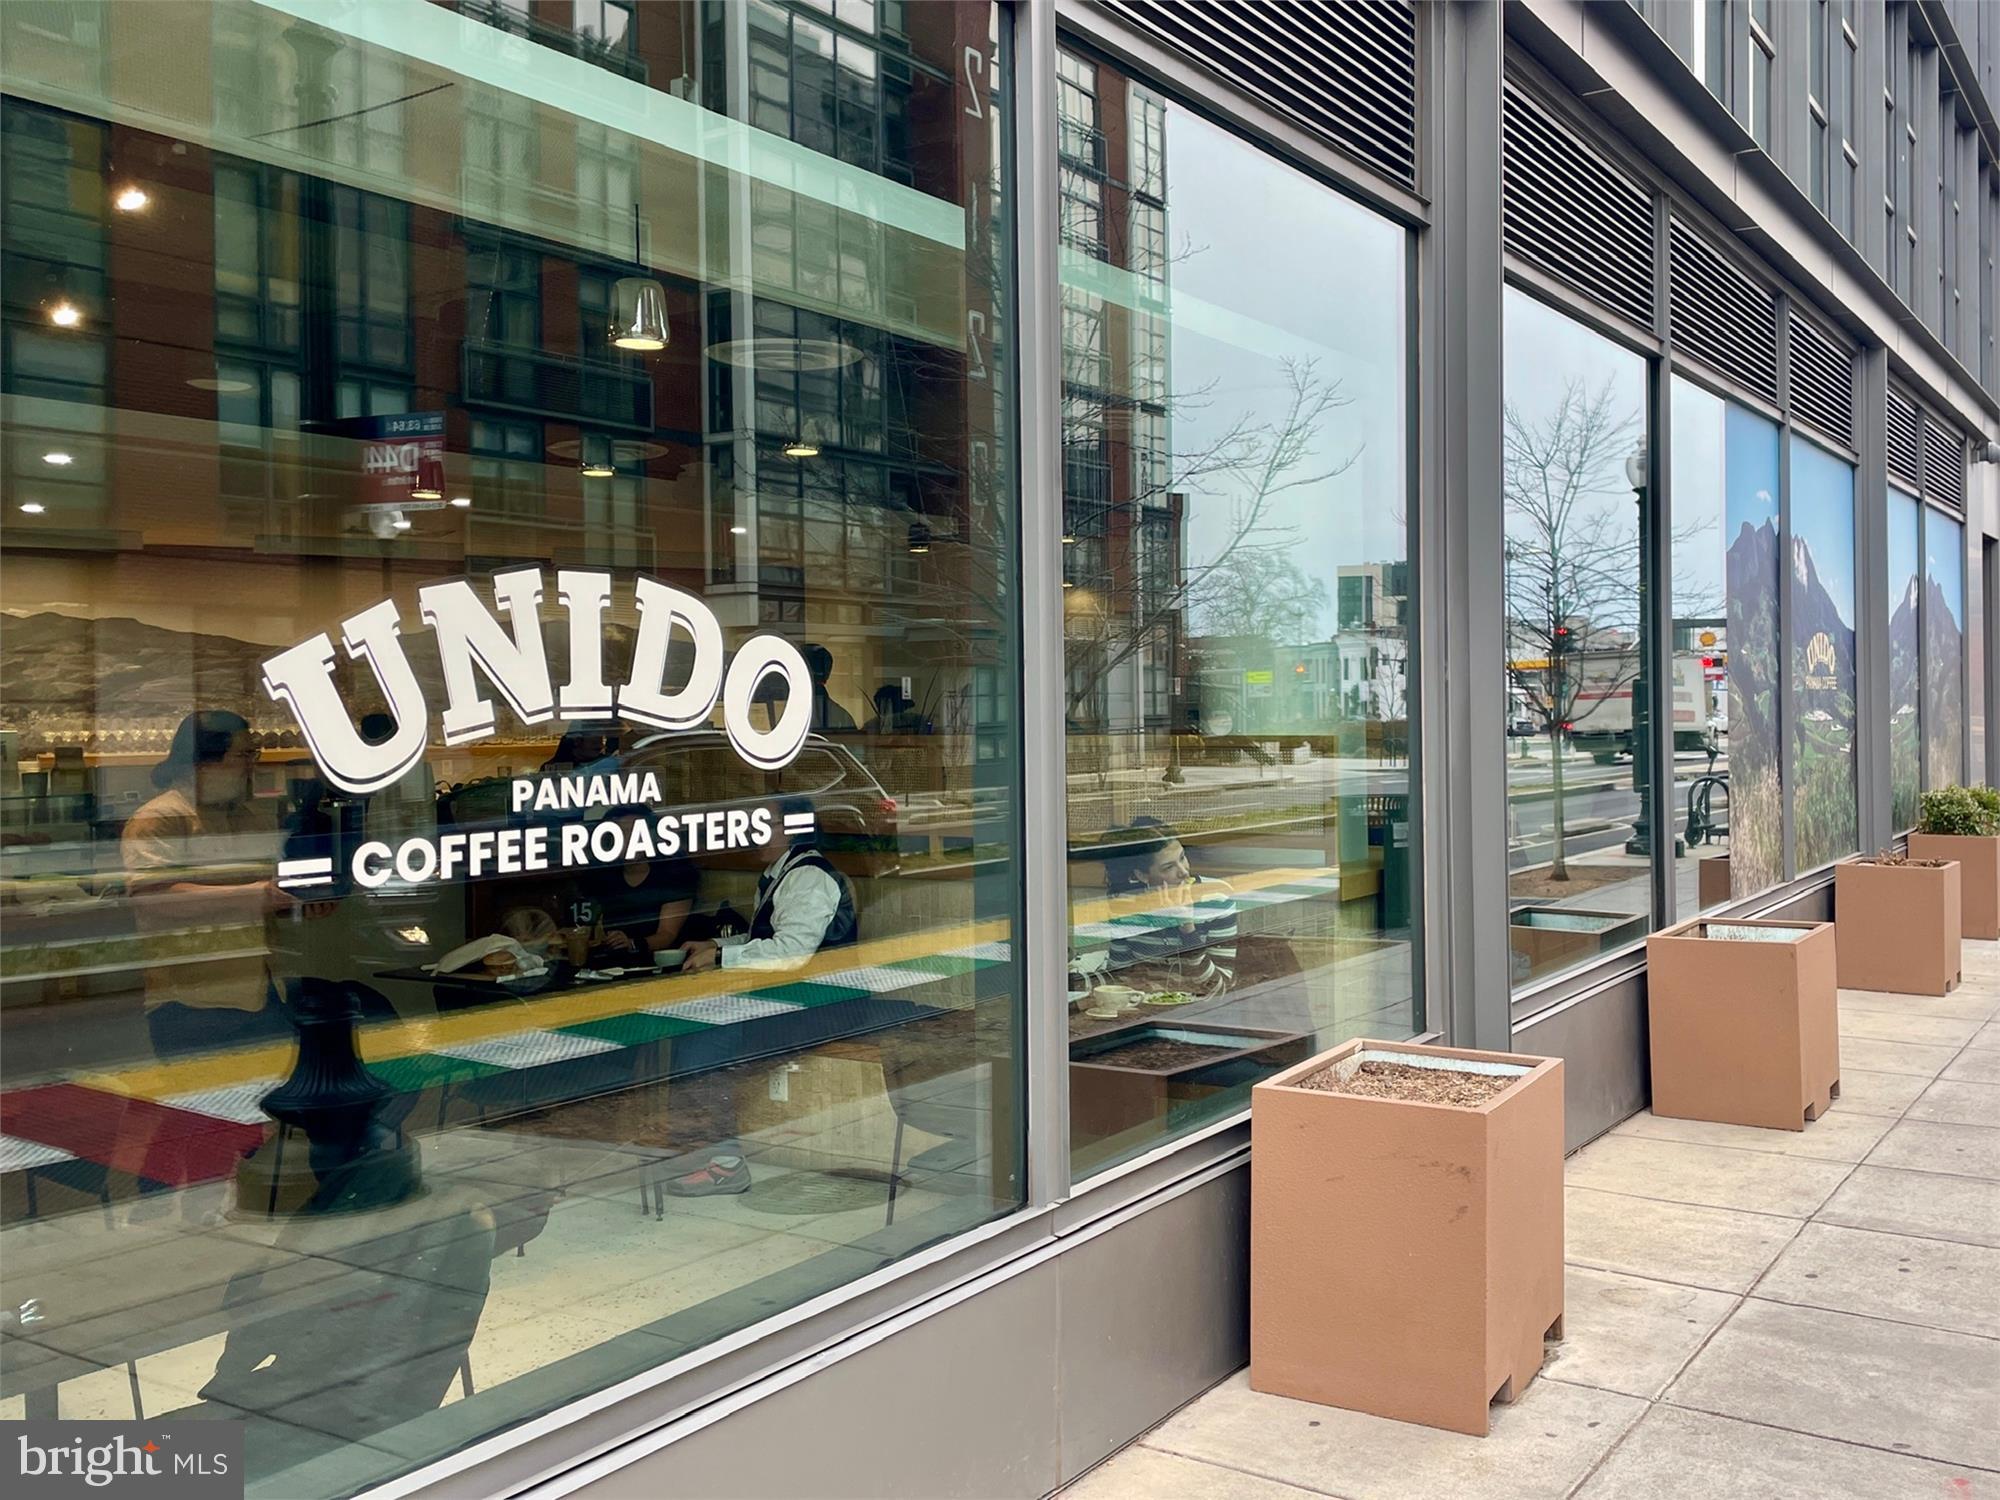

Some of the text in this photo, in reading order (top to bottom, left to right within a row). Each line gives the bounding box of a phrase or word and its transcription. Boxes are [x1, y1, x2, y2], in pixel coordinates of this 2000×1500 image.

[261, 567, 814, 794] UNIDO
[511, 771, 662, 813] PANAMA
[351, 807, 773, 888] COFFEE ROASTERS
[570, 902, 592, 922] 15
